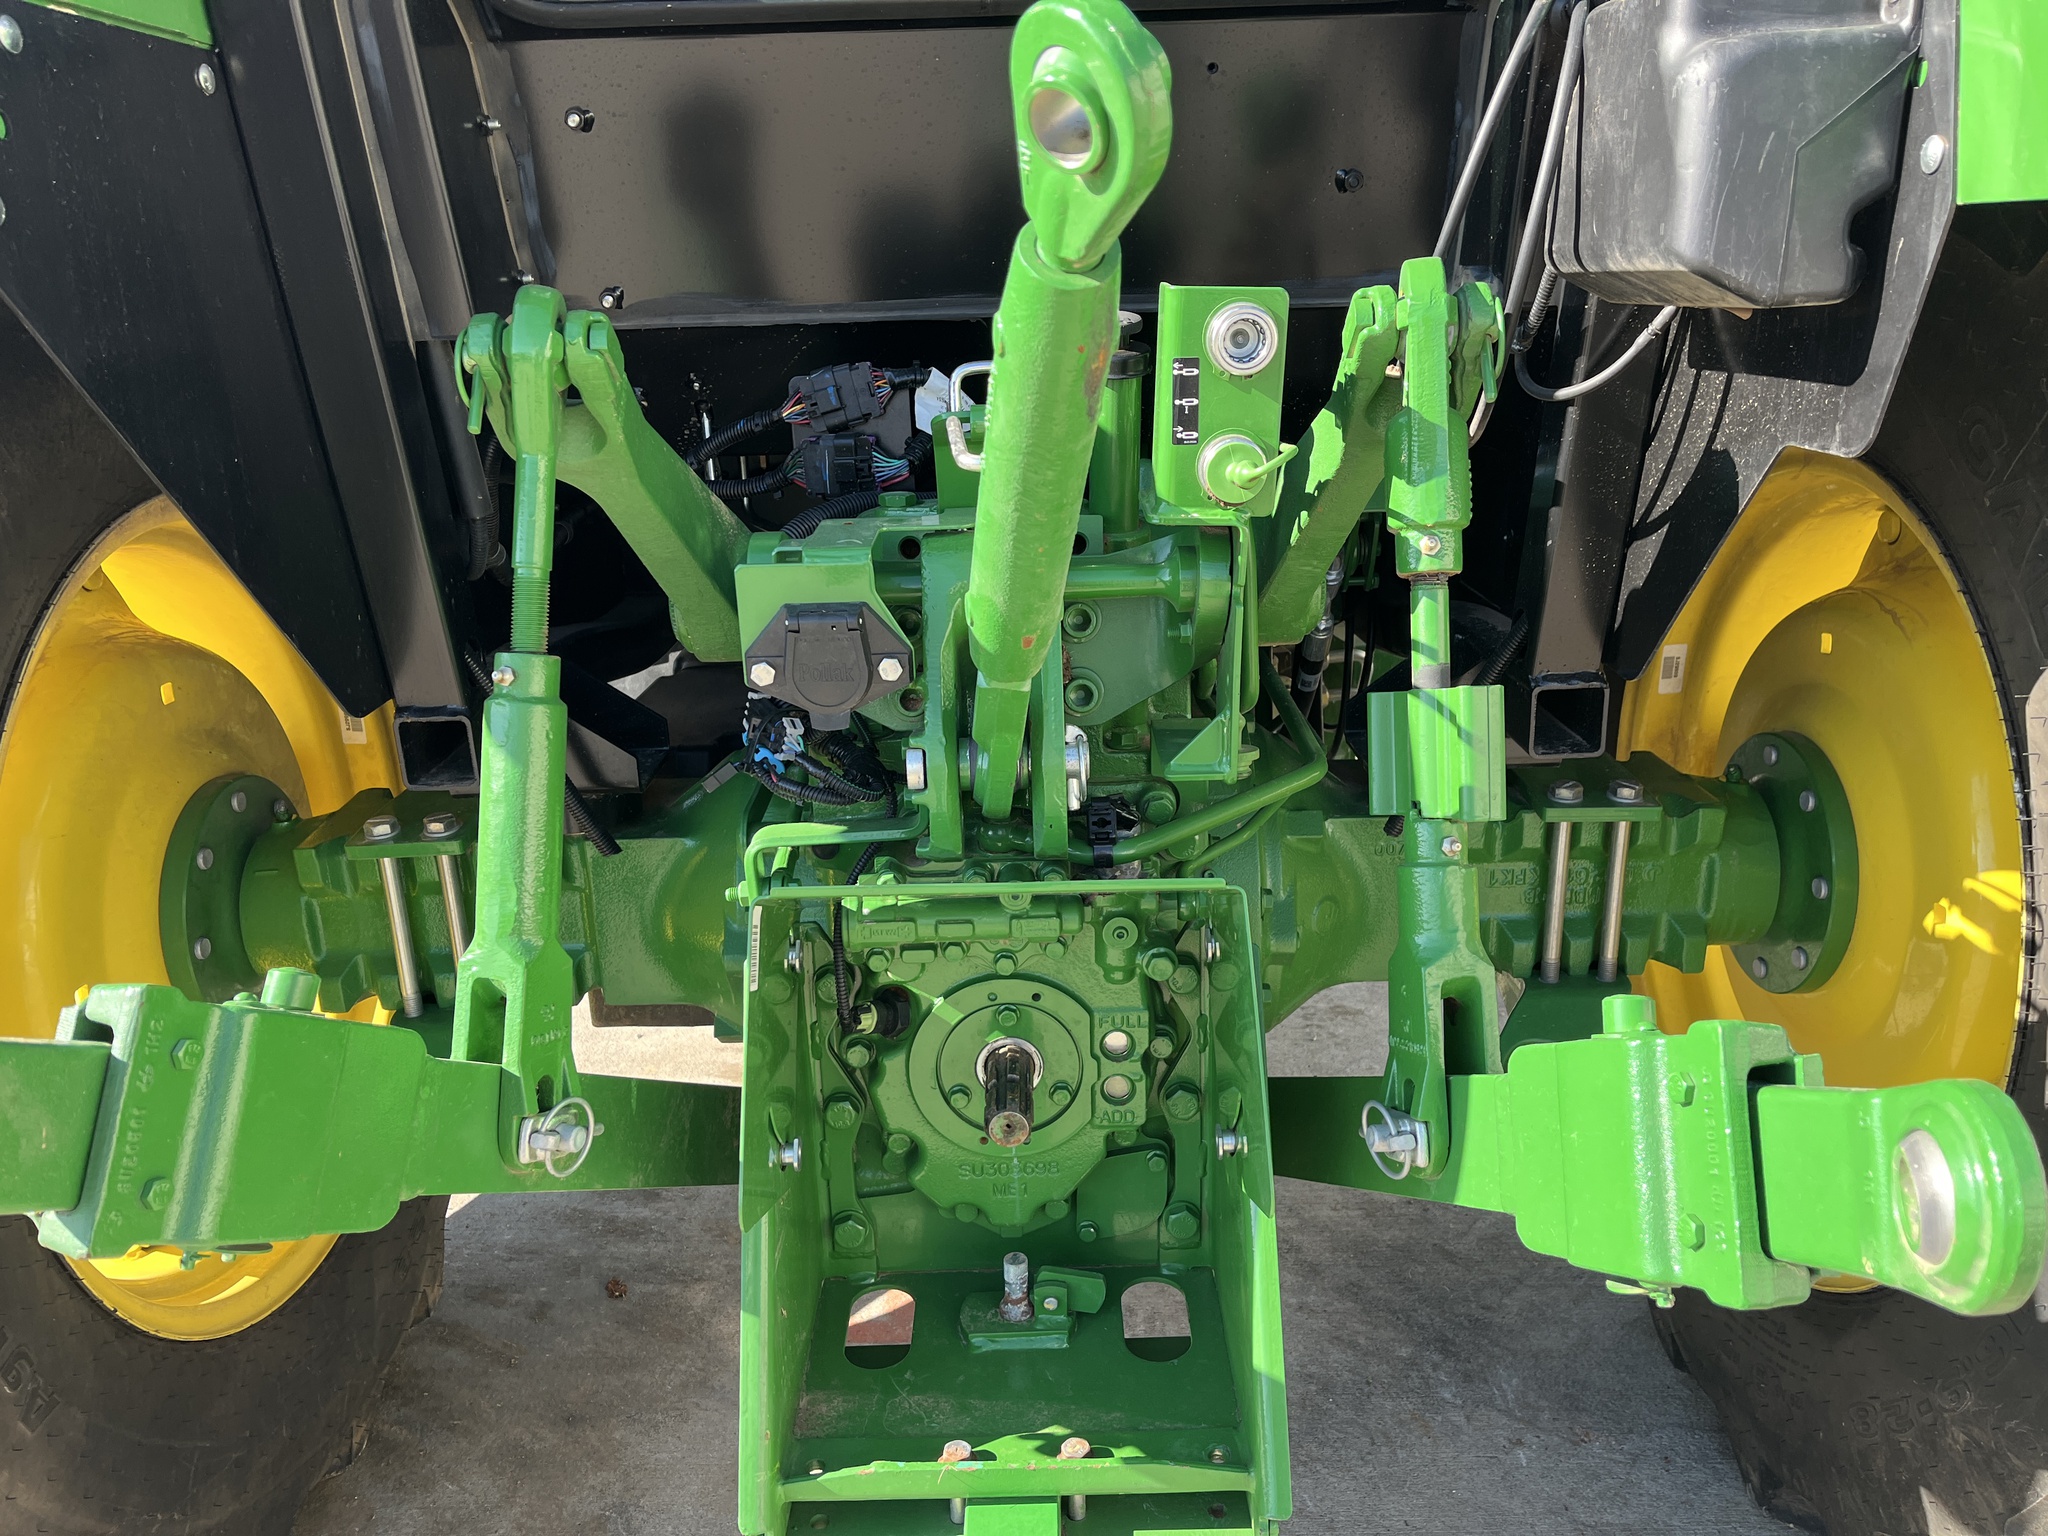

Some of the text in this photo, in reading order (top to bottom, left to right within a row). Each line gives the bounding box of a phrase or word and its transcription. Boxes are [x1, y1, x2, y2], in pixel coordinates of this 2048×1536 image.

[798, 663, 854, 682] Pollak
[1098, 1015, 1147, 1028] FULL
[1101, 1109, 1136, 1123] ADD
